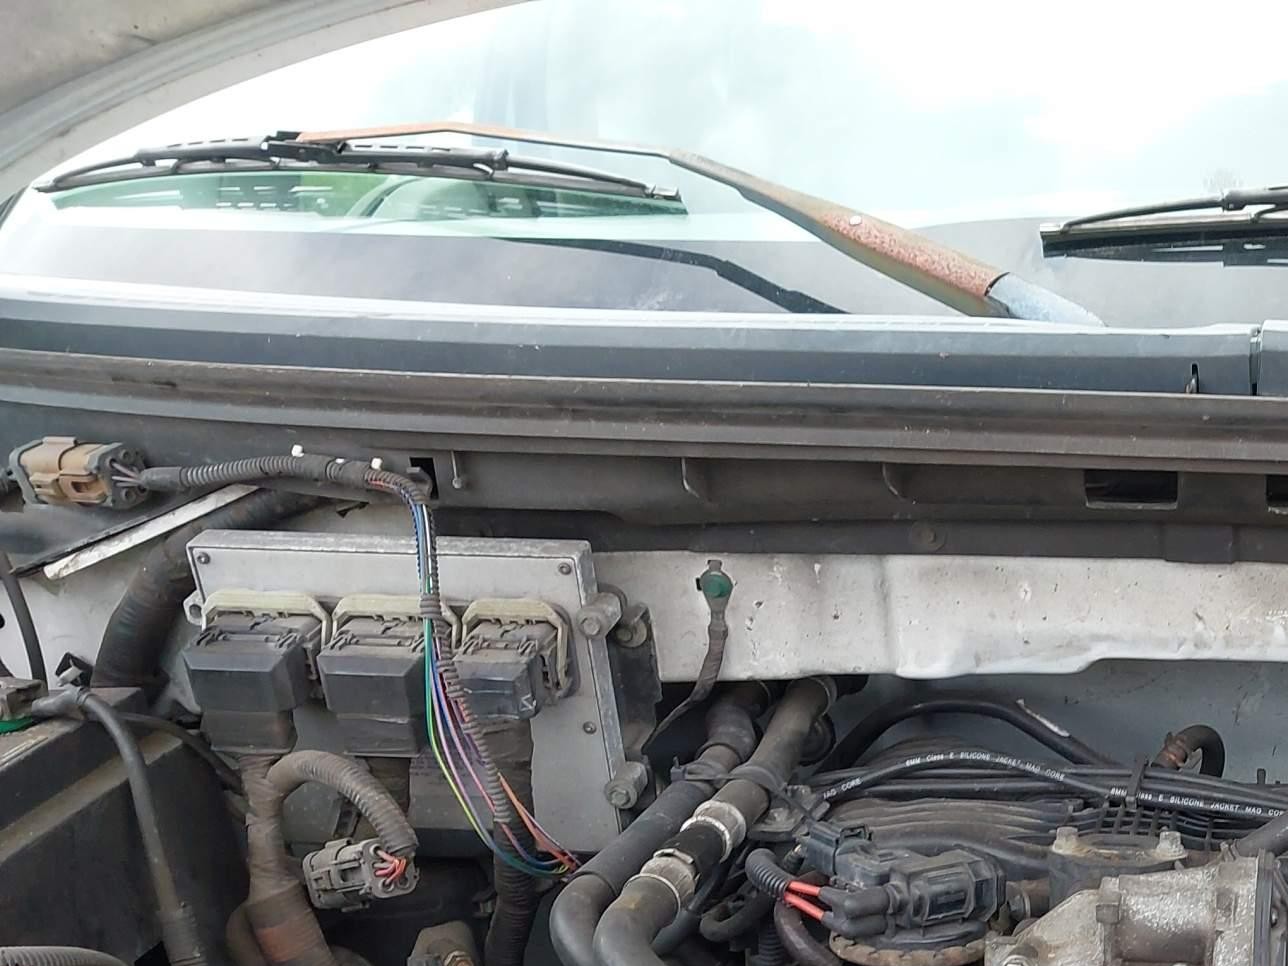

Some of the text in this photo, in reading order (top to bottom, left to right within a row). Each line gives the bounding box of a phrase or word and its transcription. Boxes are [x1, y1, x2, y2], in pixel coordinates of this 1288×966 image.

[959, 751, 991, 762] SILICONE
[1169, 795, 1204, 808] SILICONE
[1210, 802, 1240, 813] JACKET
